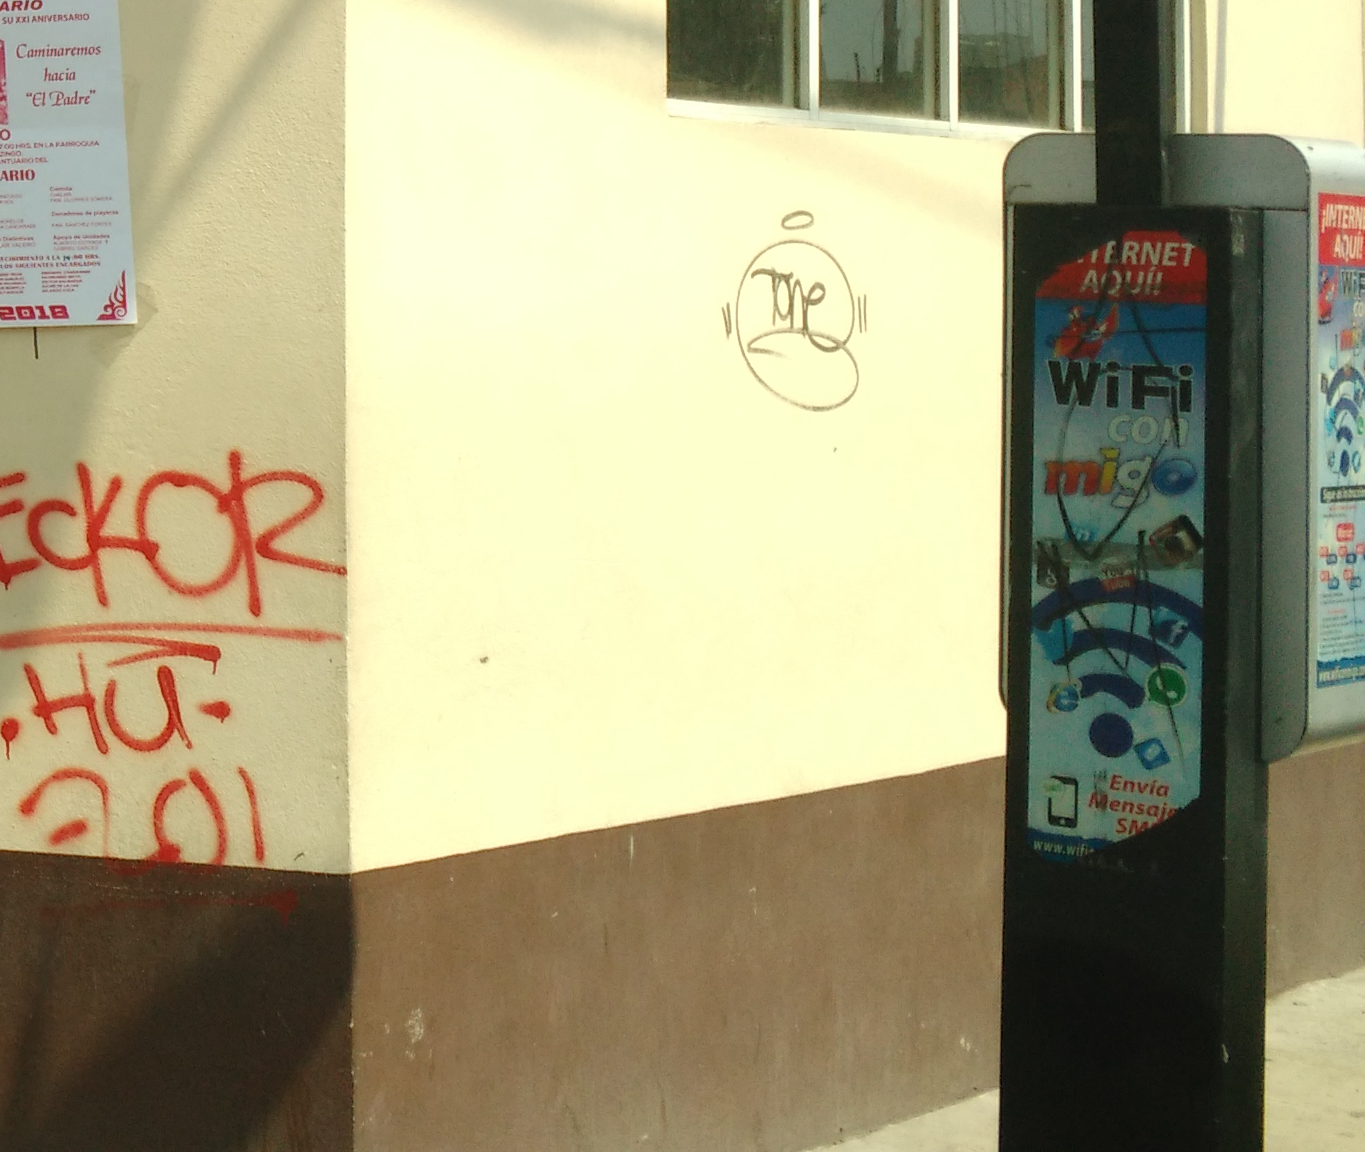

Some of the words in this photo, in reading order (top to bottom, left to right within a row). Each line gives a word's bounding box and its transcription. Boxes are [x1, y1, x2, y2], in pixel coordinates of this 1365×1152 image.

[1, 16, 13, 26] SU
[15, 16, 29, 25] XXI
[31, 13, 89, 25] ANIVERSARIO
[15, 42, 101, 59] Caminaremos
[43, 67, 76, 82] hacia
[1047, 360, 1194, 413] WiFi
[1107, 415, 1189, 447] con
[1043, 447, 1197, 508] migo
[1109, 774, 1169, 798] Envía
